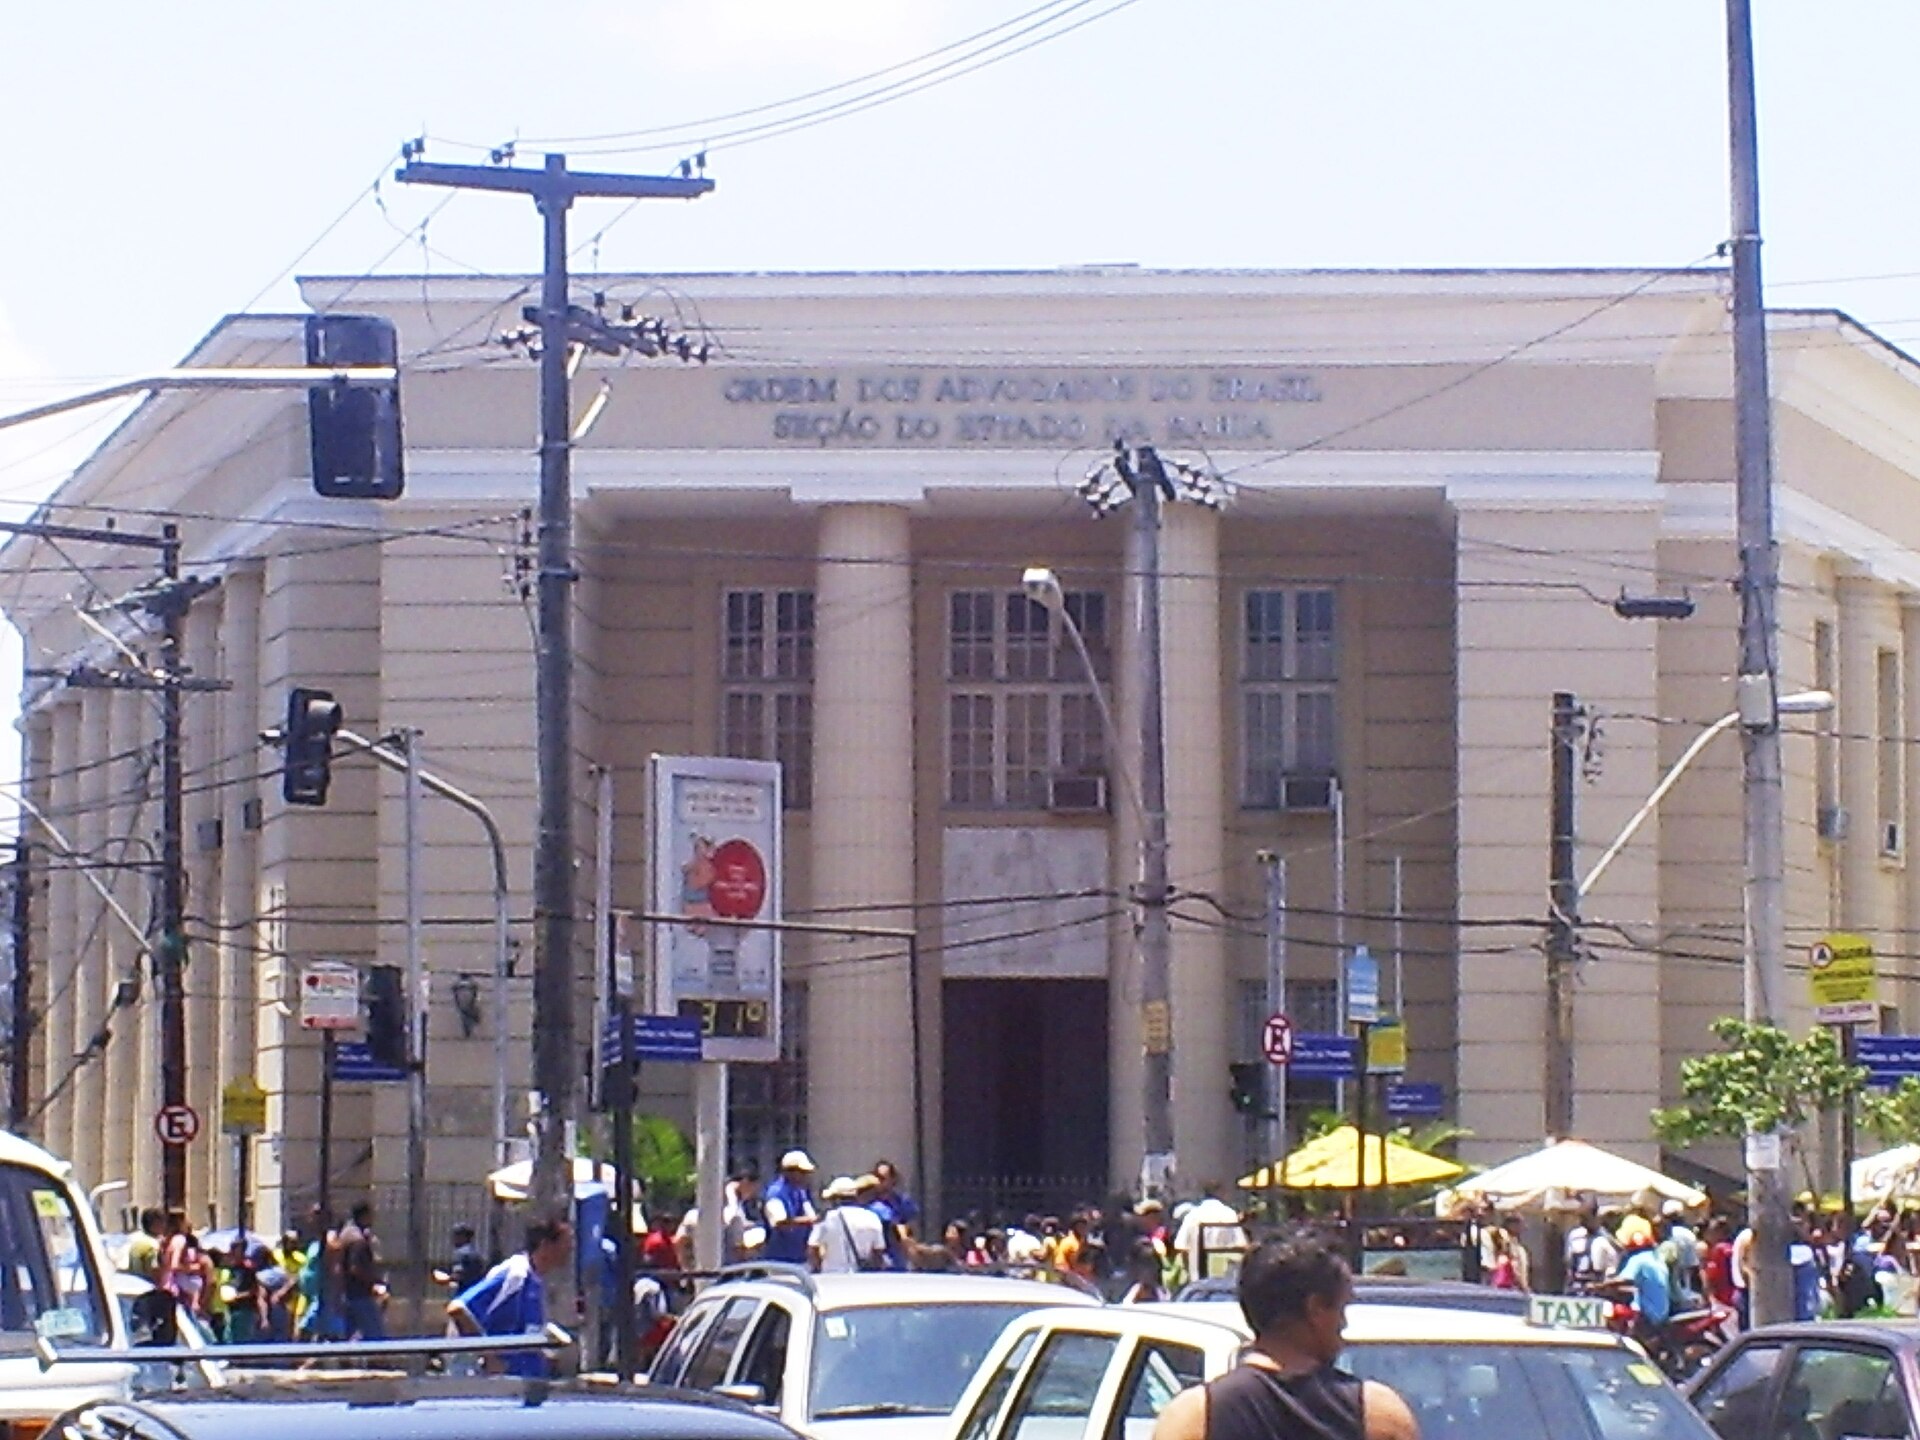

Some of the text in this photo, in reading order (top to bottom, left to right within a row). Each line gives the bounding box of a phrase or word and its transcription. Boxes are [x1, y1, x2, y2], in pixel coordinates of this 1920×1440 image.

[725, 378, 837, 403] ORDEM
[857, 378, 920, 402] DOS
[897, 414, 938, 440] DO
[1537, 1301, 1602, 1325] TAXI
